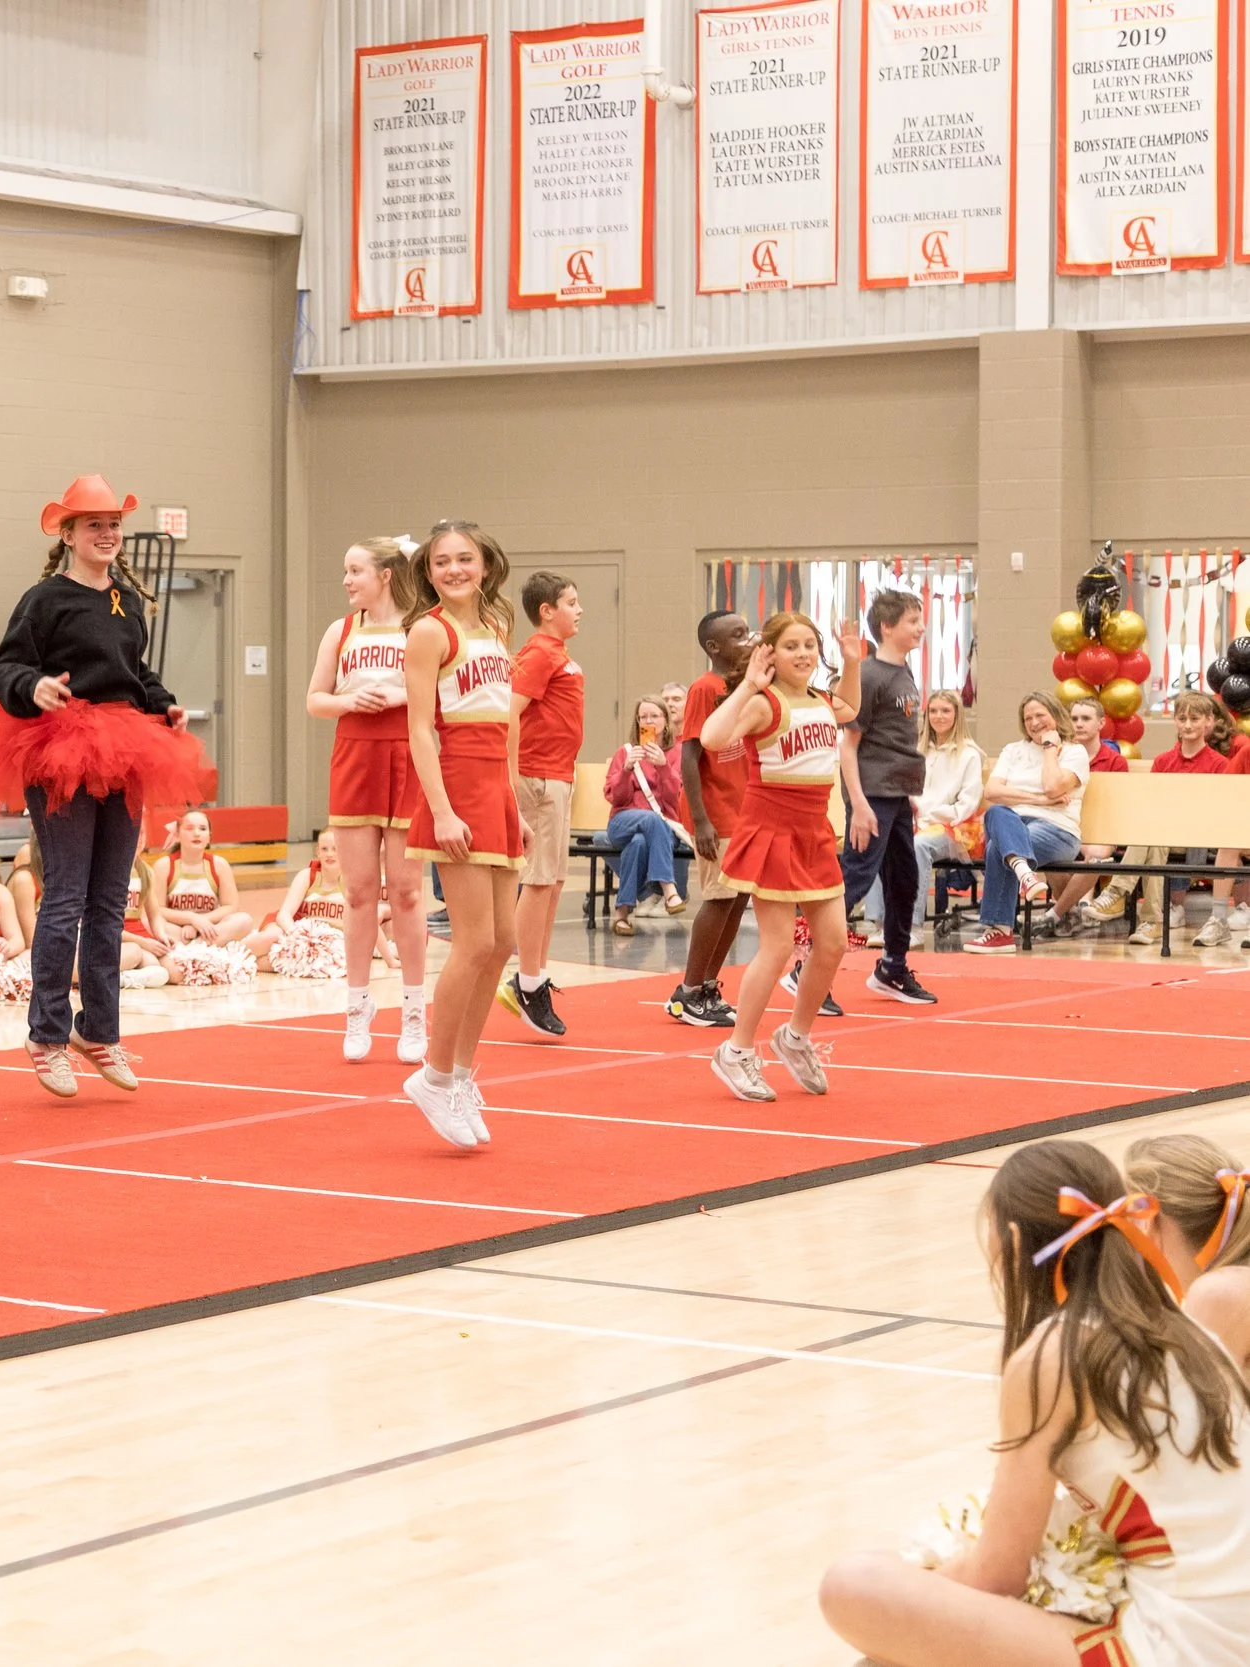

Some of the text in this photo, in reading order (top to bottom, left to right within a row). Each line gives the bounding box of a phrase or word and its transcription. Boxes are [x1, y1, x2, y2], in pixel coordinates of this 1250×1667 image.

[892, 0, 988, 20] WARRIOR
[1111, 3, 1175, 22] TENNIS
[707, 12, 829, 38] LADY WARRIOR
[894, 21, 982, 40] BOYS TENNIS
[721, 35, 815, 54] GIRLS TENNIS
[1117, 27, 1167, 48] 2019
[531, 40, 640, 63] LADY WARRIOR
[920, 45, 958, 61] 2021
[367, 56, 474, 78] LADY WARRIOR
[561, 63, 607, 79] GOLF
[750, 58, 785, 75] 2021
[879, 57, 1000, 81] STATE RUNNER-UP
[1072, 49, 1213, 75] GIRLS STATE CHAMPIONS
[404, 79, 435, 91] GOLF
[710, 71, 826, 96] STATE RUNNER-UP
[1093, 70, 1193, 89] LAURYN FRANKS
[565, 84, 601, 101] 2022
[1095, 86, 1190, 104] KATE WURSTER
[404, 97, 435, 113] 2021
[530, 100, 636, 125] STATE RUNNER-UP
[1081, 99, 1203, 124] JULIENNE SWEENEY
[374, 110, 466, 131] STATE RUNNER-UP
[903, 112, 974, 130] JW ALTMAN
[537, 129, 628, 146] KELSEY WILSON
[709, 122, 826, 144] MADDIE HOOKER
[894, 126, 983, 144] ALEX ZARDIAN
[1074, 130, 1209, 153] BOYS STATE CHAMPIONS
[432, 140, 454, 151] LANE
[539, 144, 626, 160] HALEY CARNES
[712, 137, 823, 159] LAURYN FRANKS
[892, 141, 985, 159] MERRICK ESTES
[532, 158, 633, 174] MADDIE HOOKER
[715, 153, 820, 173] KATE WURSTER
[875, 154, 1002, 175] AUSTIN SANTELLANA
[1103, 151, 1176, 170] JW ALTMAN
[534, 172, 630, 188] BROOKLYN LANE
[714, 168, 820, 188] TATUM SNYDER
[1077, 164, 1205, 184] AUSTIN SANTELLANA
[542, 187, 623, 201] MARIS HARRIS
[1095, 181, 1187, 199] ALEX ZARDAIN
[913, 210, 958, 221] MICHAEL
[962, 207, 1002, 218] TURNER
[568, 225, 592, 235] DREW
[596, 224, 629, 234] CARNES
[744, 222, 787, 233] MICHAEL
[790, 219, 829, 230] TURNER
[1117, 258, 1166, 270] WARRIORS
[342, 644, 406, 678] WARRIOR
[298, 900, 345, 919] ARRIOR
